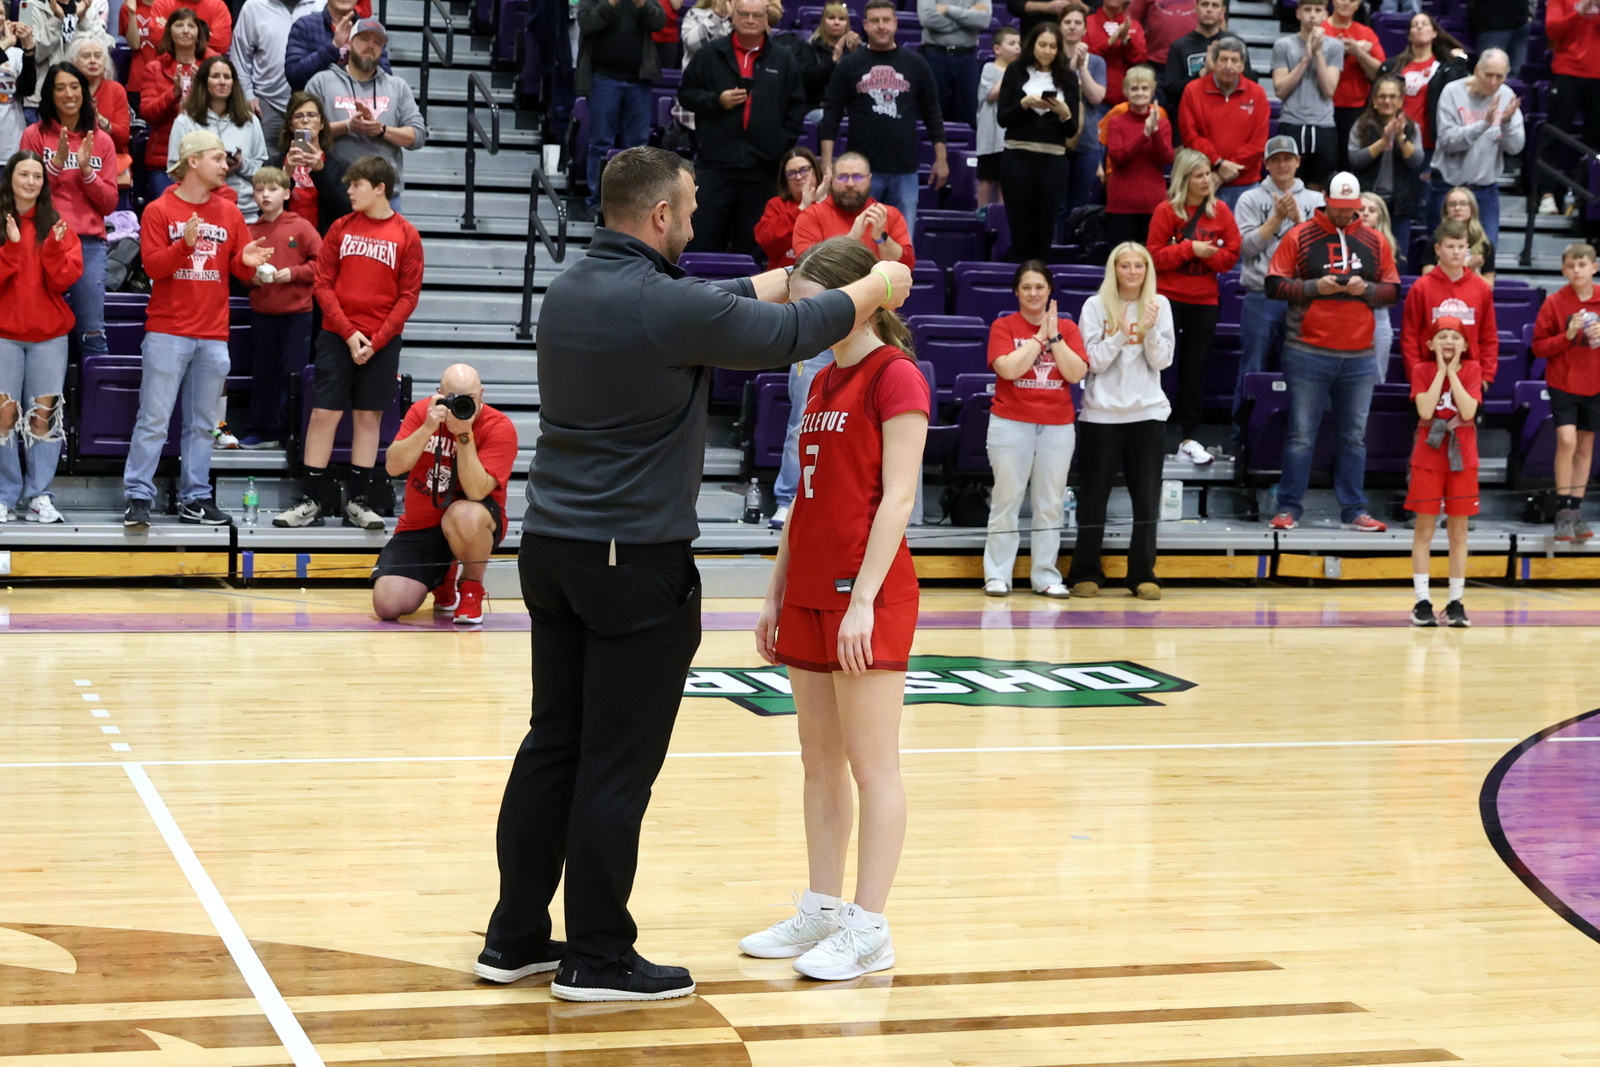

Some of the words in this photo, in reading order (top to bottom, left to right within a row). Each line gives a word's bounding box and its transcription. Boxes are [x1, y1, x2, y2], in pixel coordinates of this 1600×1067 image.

[339, 233, 398, 270] REDMEN
[1326, 243, 1351, 275] B
[800, 411, 849, 434] ELLEVUE
[803, 444, 820, 499] 2
